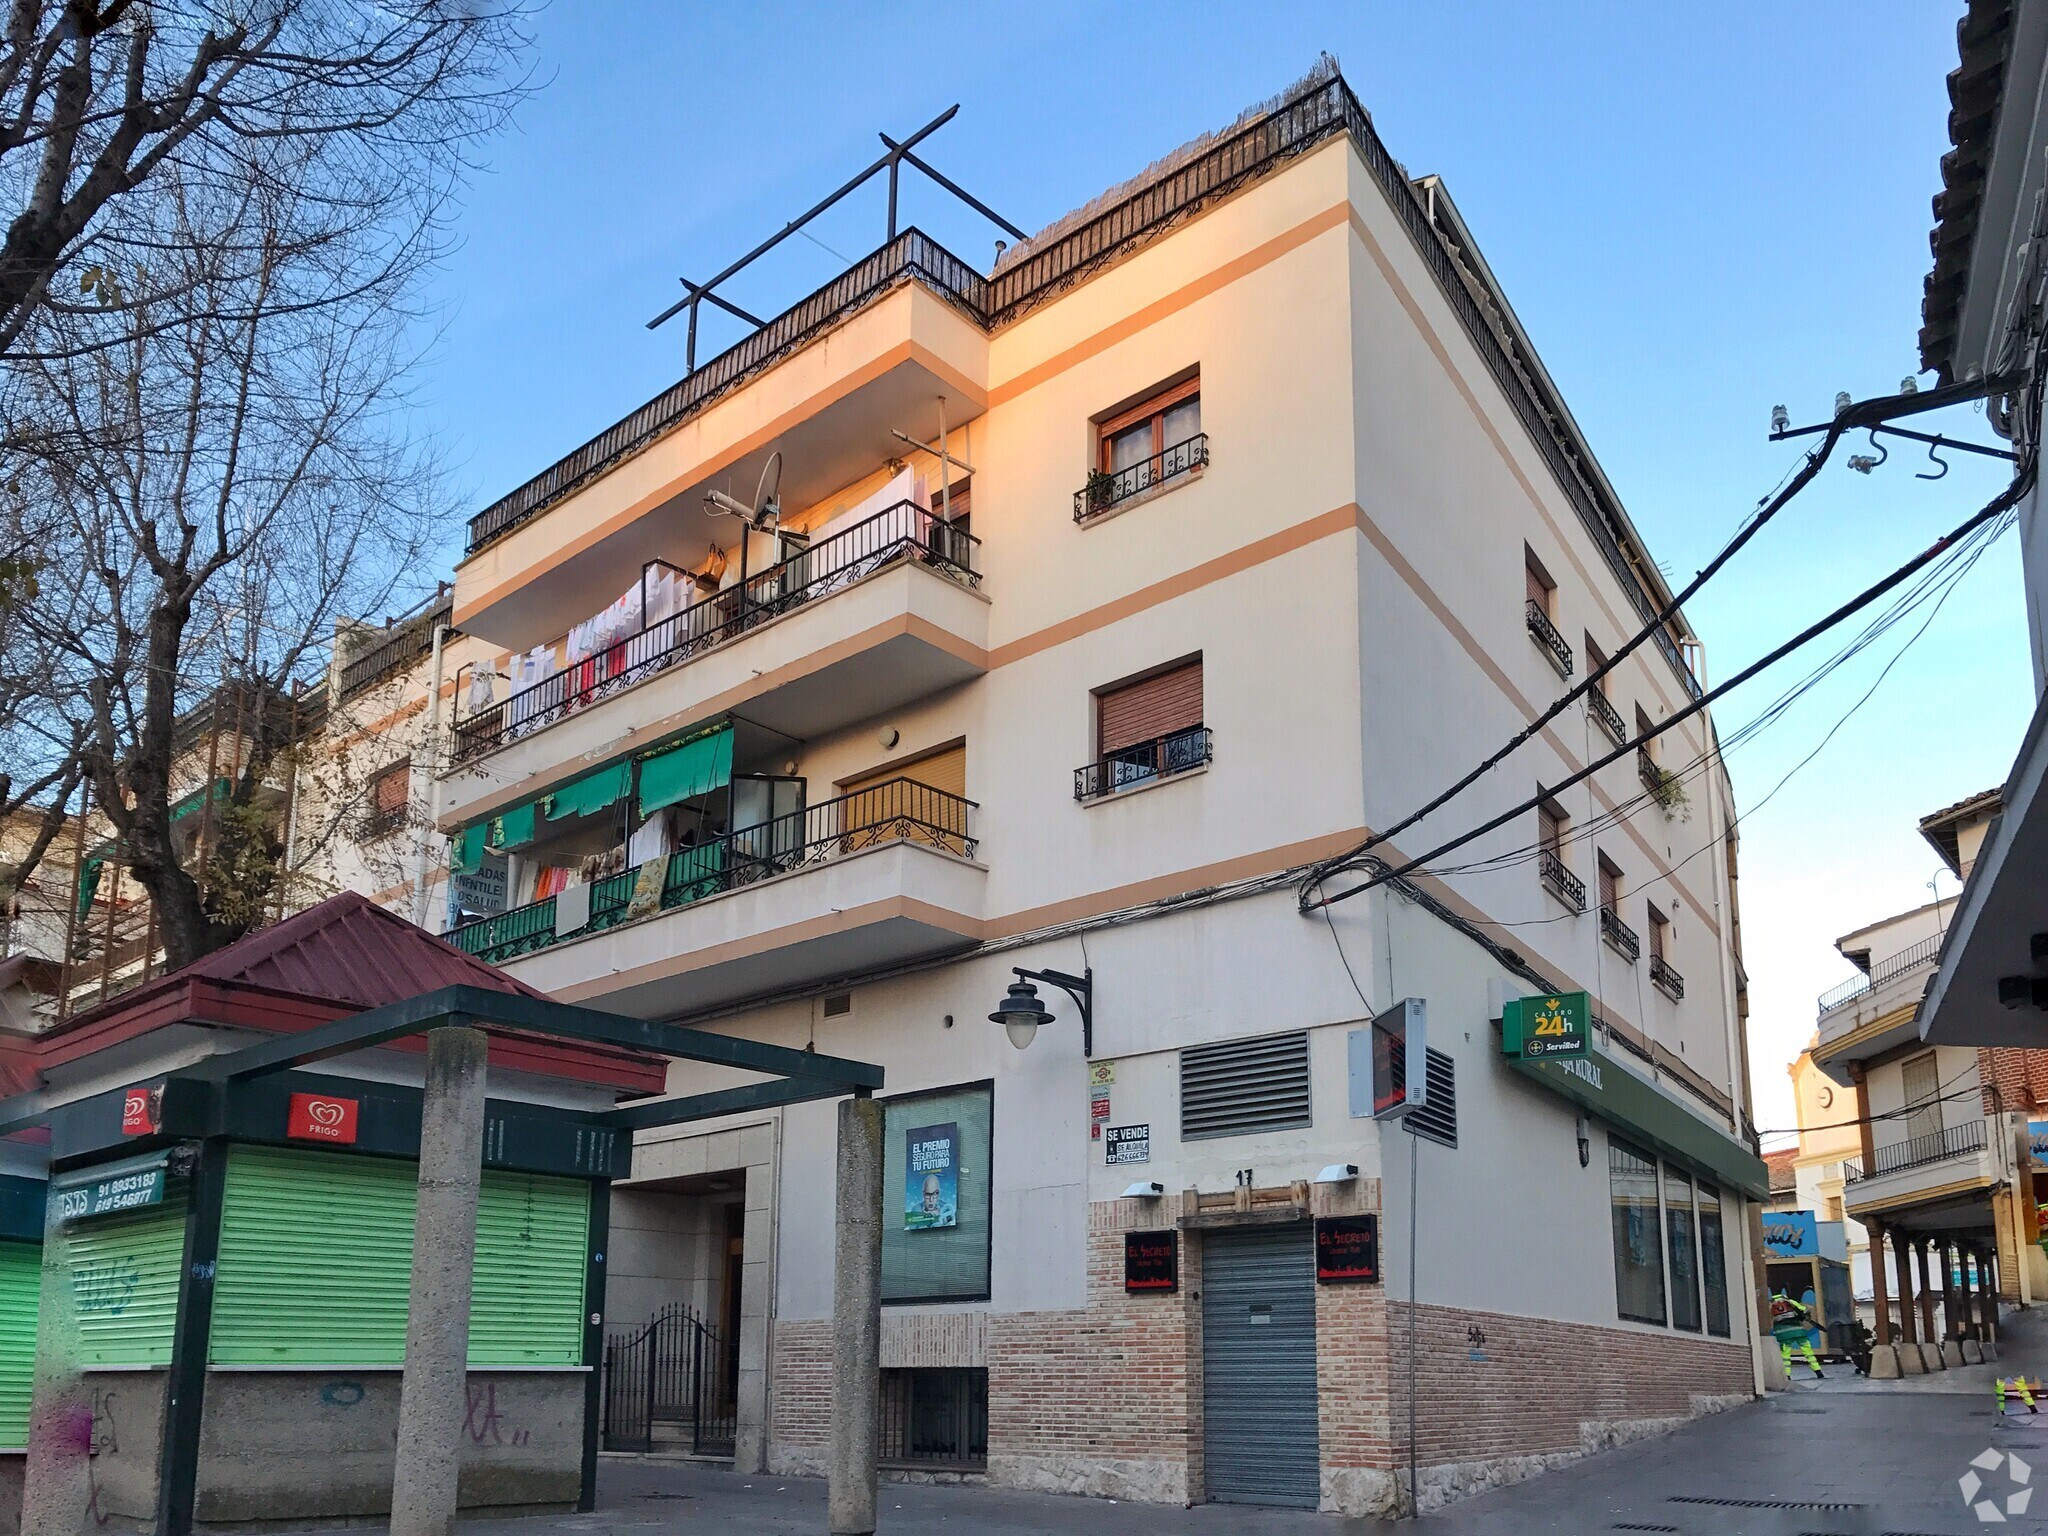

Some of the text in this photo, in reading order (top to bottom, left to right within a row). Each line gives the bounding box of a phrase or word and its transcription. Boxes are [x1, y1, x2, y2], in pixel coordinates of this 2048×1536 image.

[1534, 1009, 1573, 1018] CAJERO
[1546, 1040, 1581, 1052] ServiRed
[1575, 1059, 1604, 1091] RURAL
[309, 1124, 339, 1137] FRIGO
[1107, 1127, 1147, 1141] SE VENDE
[913, 1139, 949, 1153] EL PREMIO
[912, 1149, 949, 1161] SEGURO PARA
[912, 1161, 921, 1171] TU
[922, 1158, 949, 1169] FUTURO
[1235, 1168, 1253, 1186] 17
[98, 1182, 109, 1198] 91
